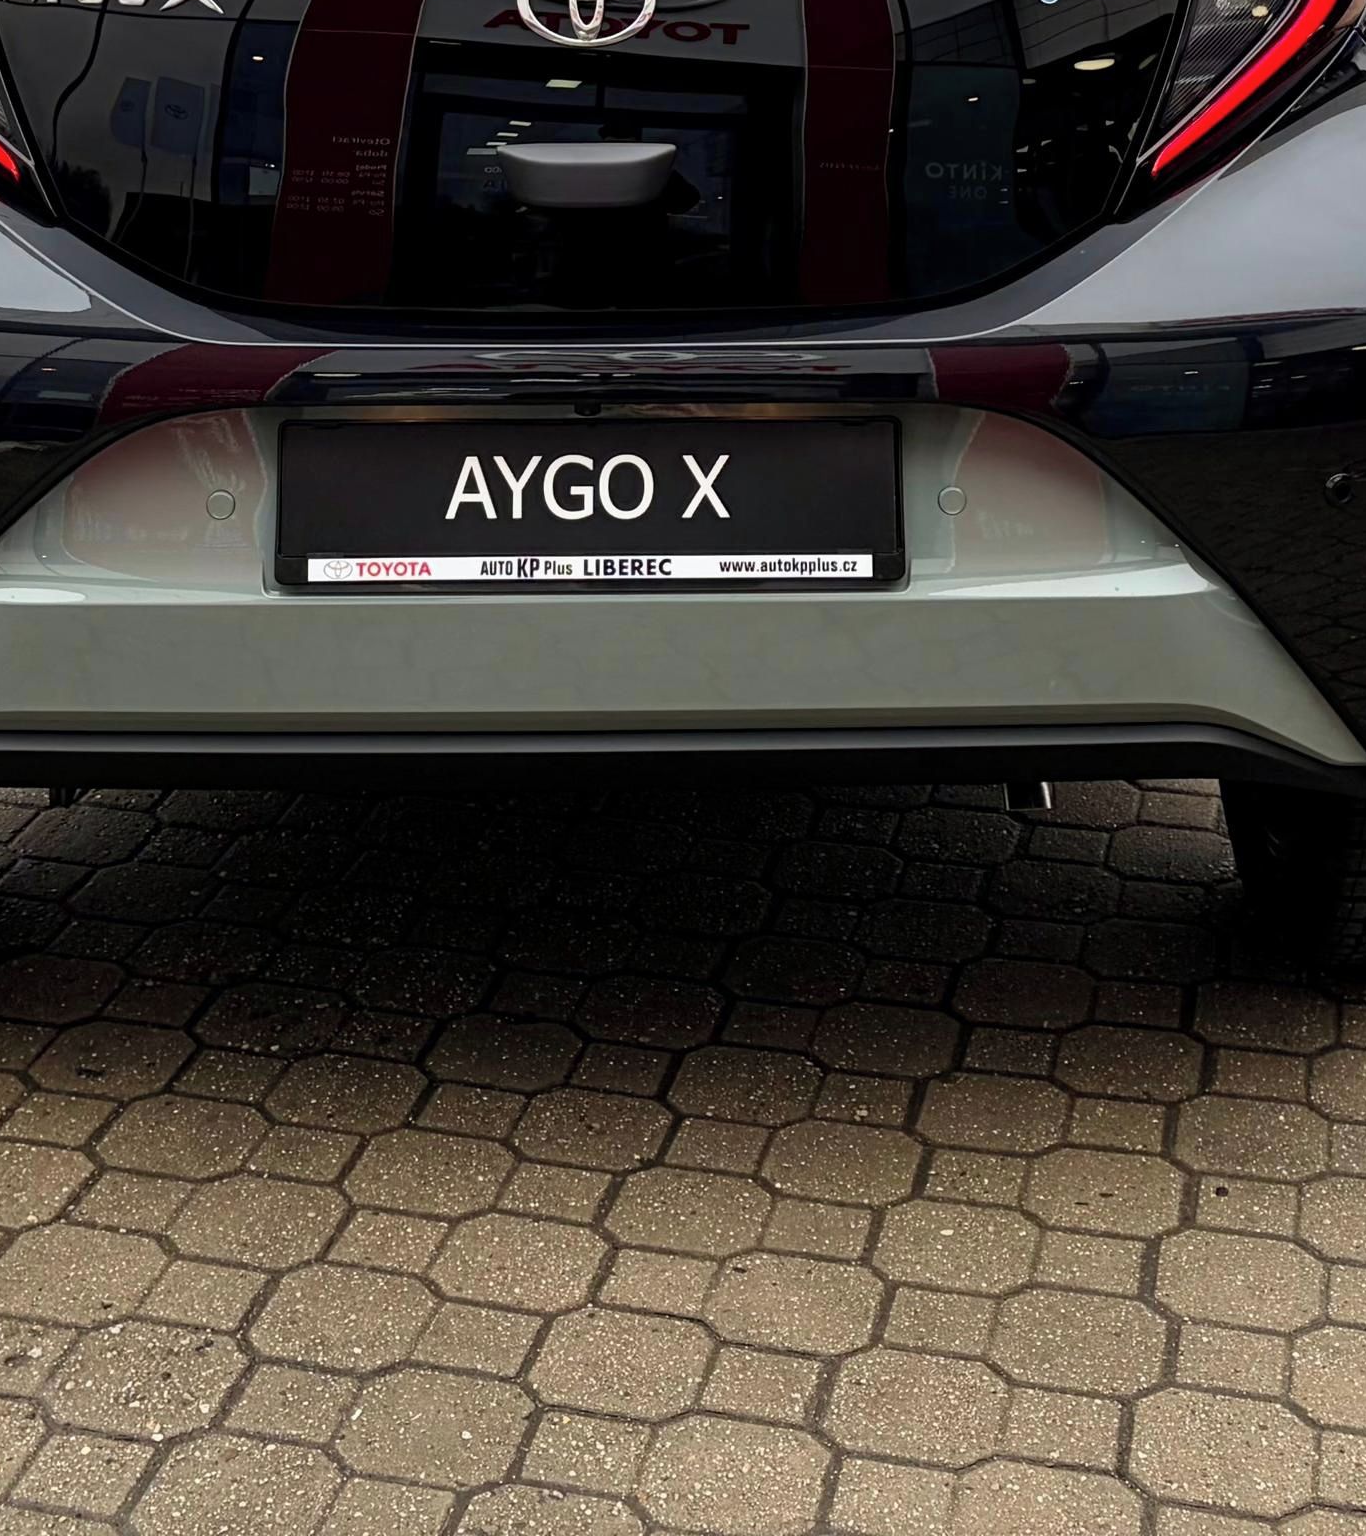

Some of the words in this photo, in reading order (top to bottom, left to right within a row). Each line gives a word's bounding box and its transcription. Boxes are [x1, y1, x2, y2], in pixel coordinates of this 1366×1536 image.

[444, 454, 654, 520] AYGO
[681, 454, 731, 519] X
[356, 561, 432, 577] TOYOTA
[480, 560, 512, 576] AUTO
[517, 558, 540, 578] KP
[544, 560, 573, 575] Plus
[583, 558, 672, 576] LIBEREC
[719, 556, 858, 575] www.autokpplus.cz
